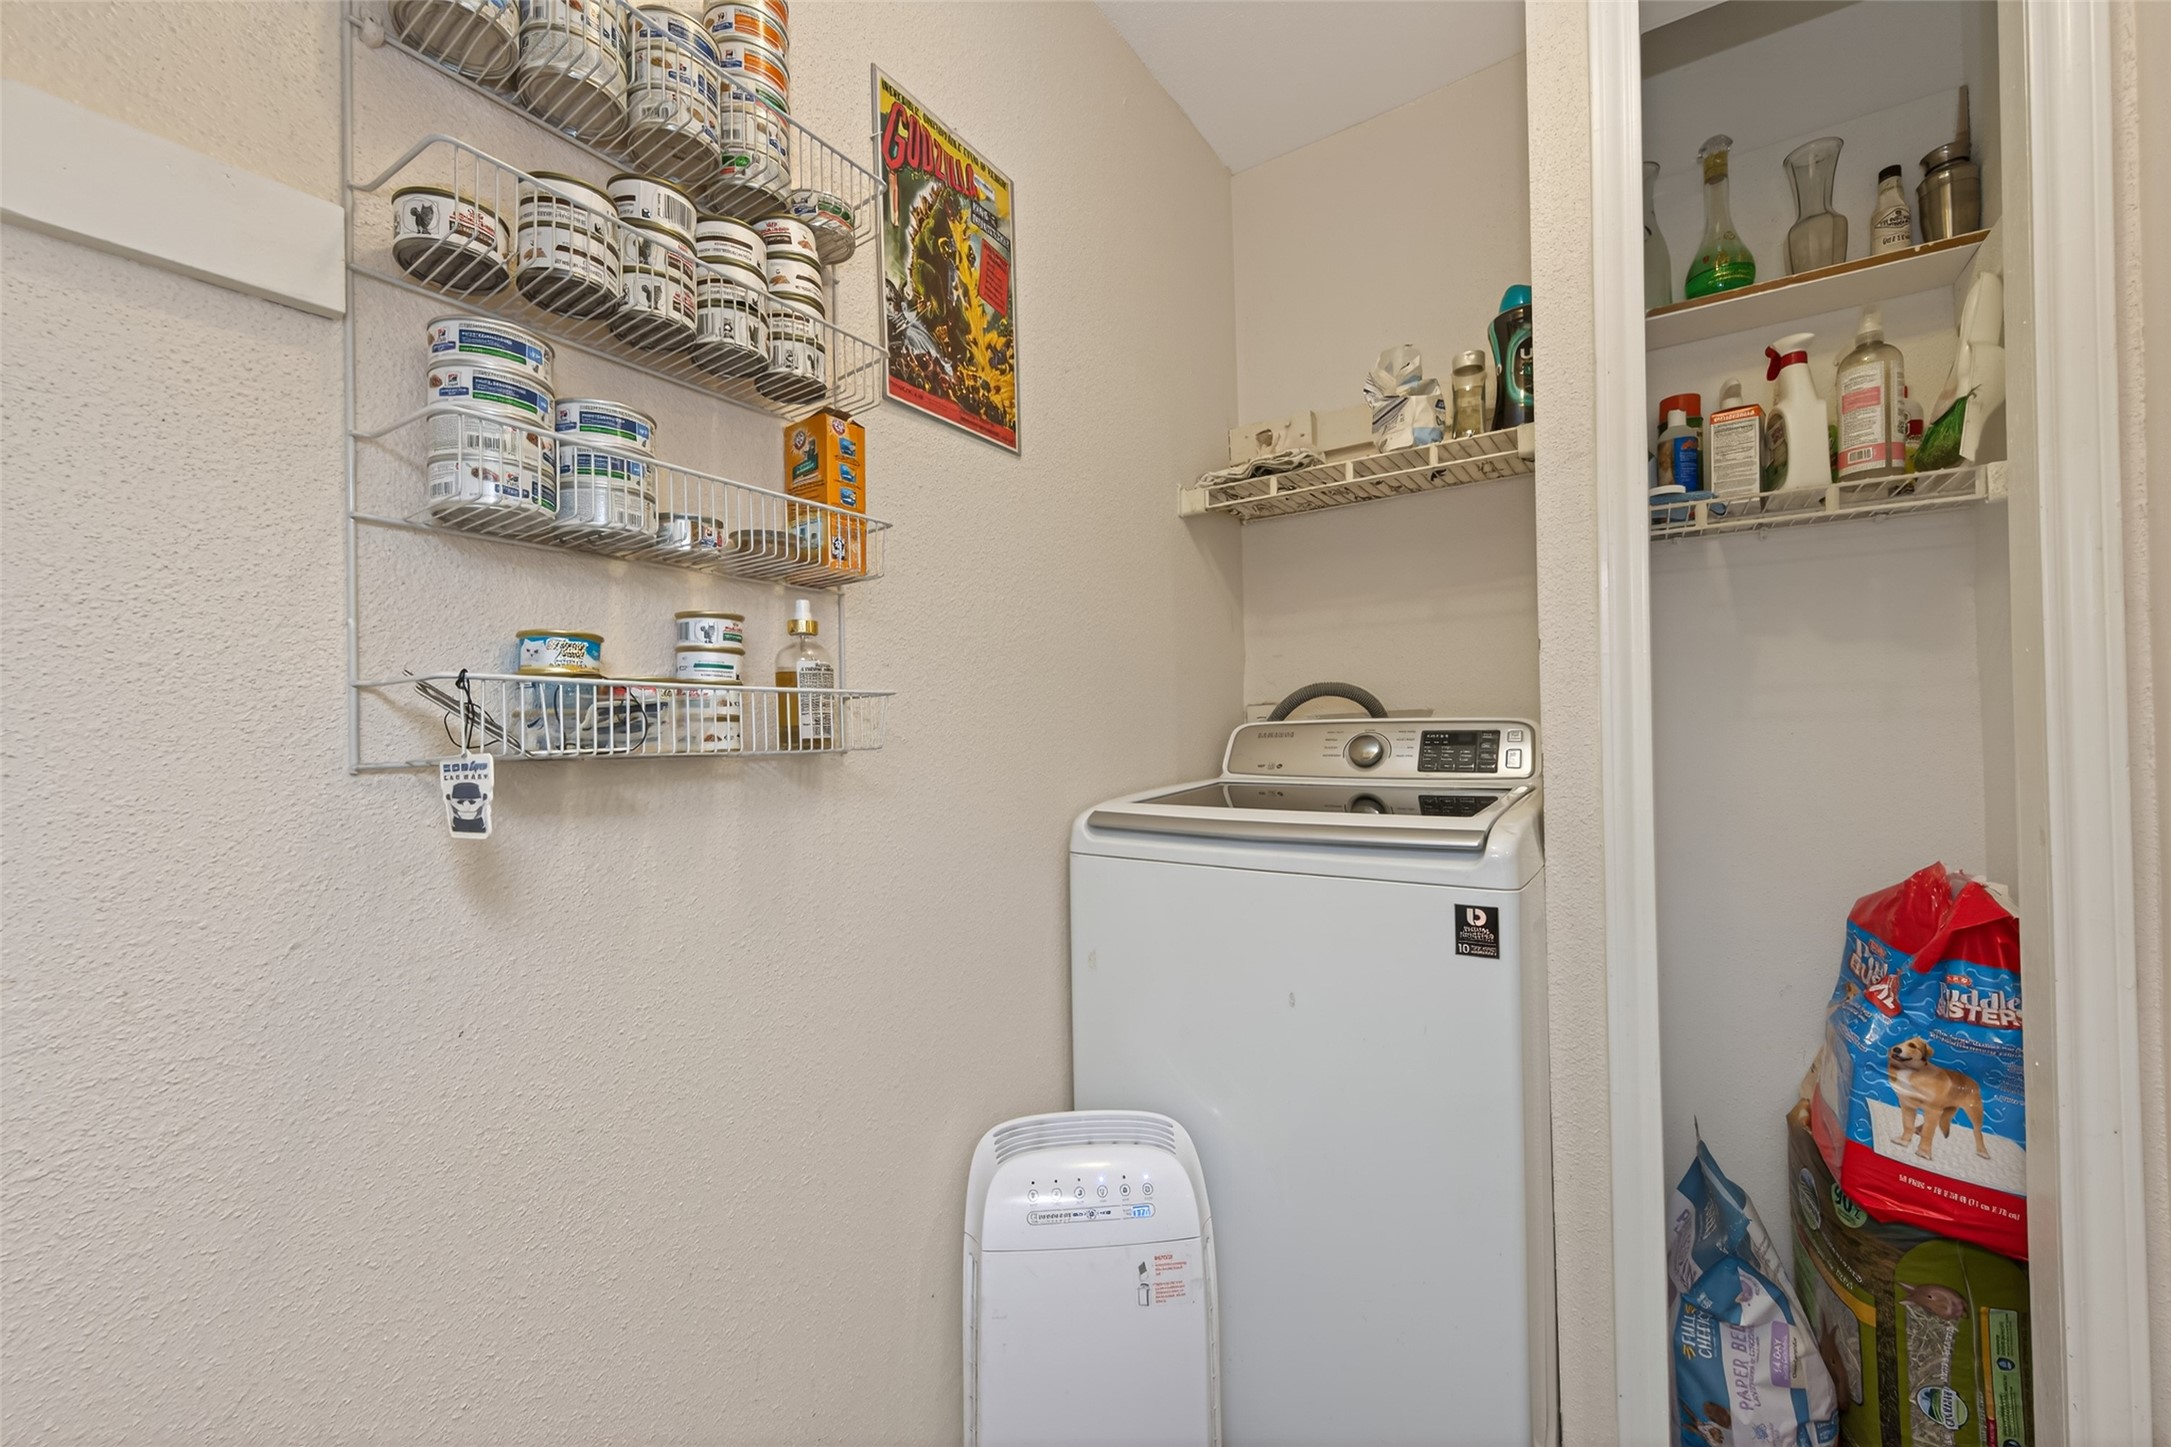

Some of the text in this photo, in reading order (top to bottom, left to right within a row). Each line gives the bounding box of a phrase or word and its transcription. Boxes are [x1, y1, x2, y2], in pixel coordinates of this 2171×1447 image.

[882, 101, 977, 198] GODZILLA
[1681, 1313, 1696, 1347] FULL
[1773, 1338, 1783, 1359] DAY
[1732, 1358, 1754, 1411] PAPER
